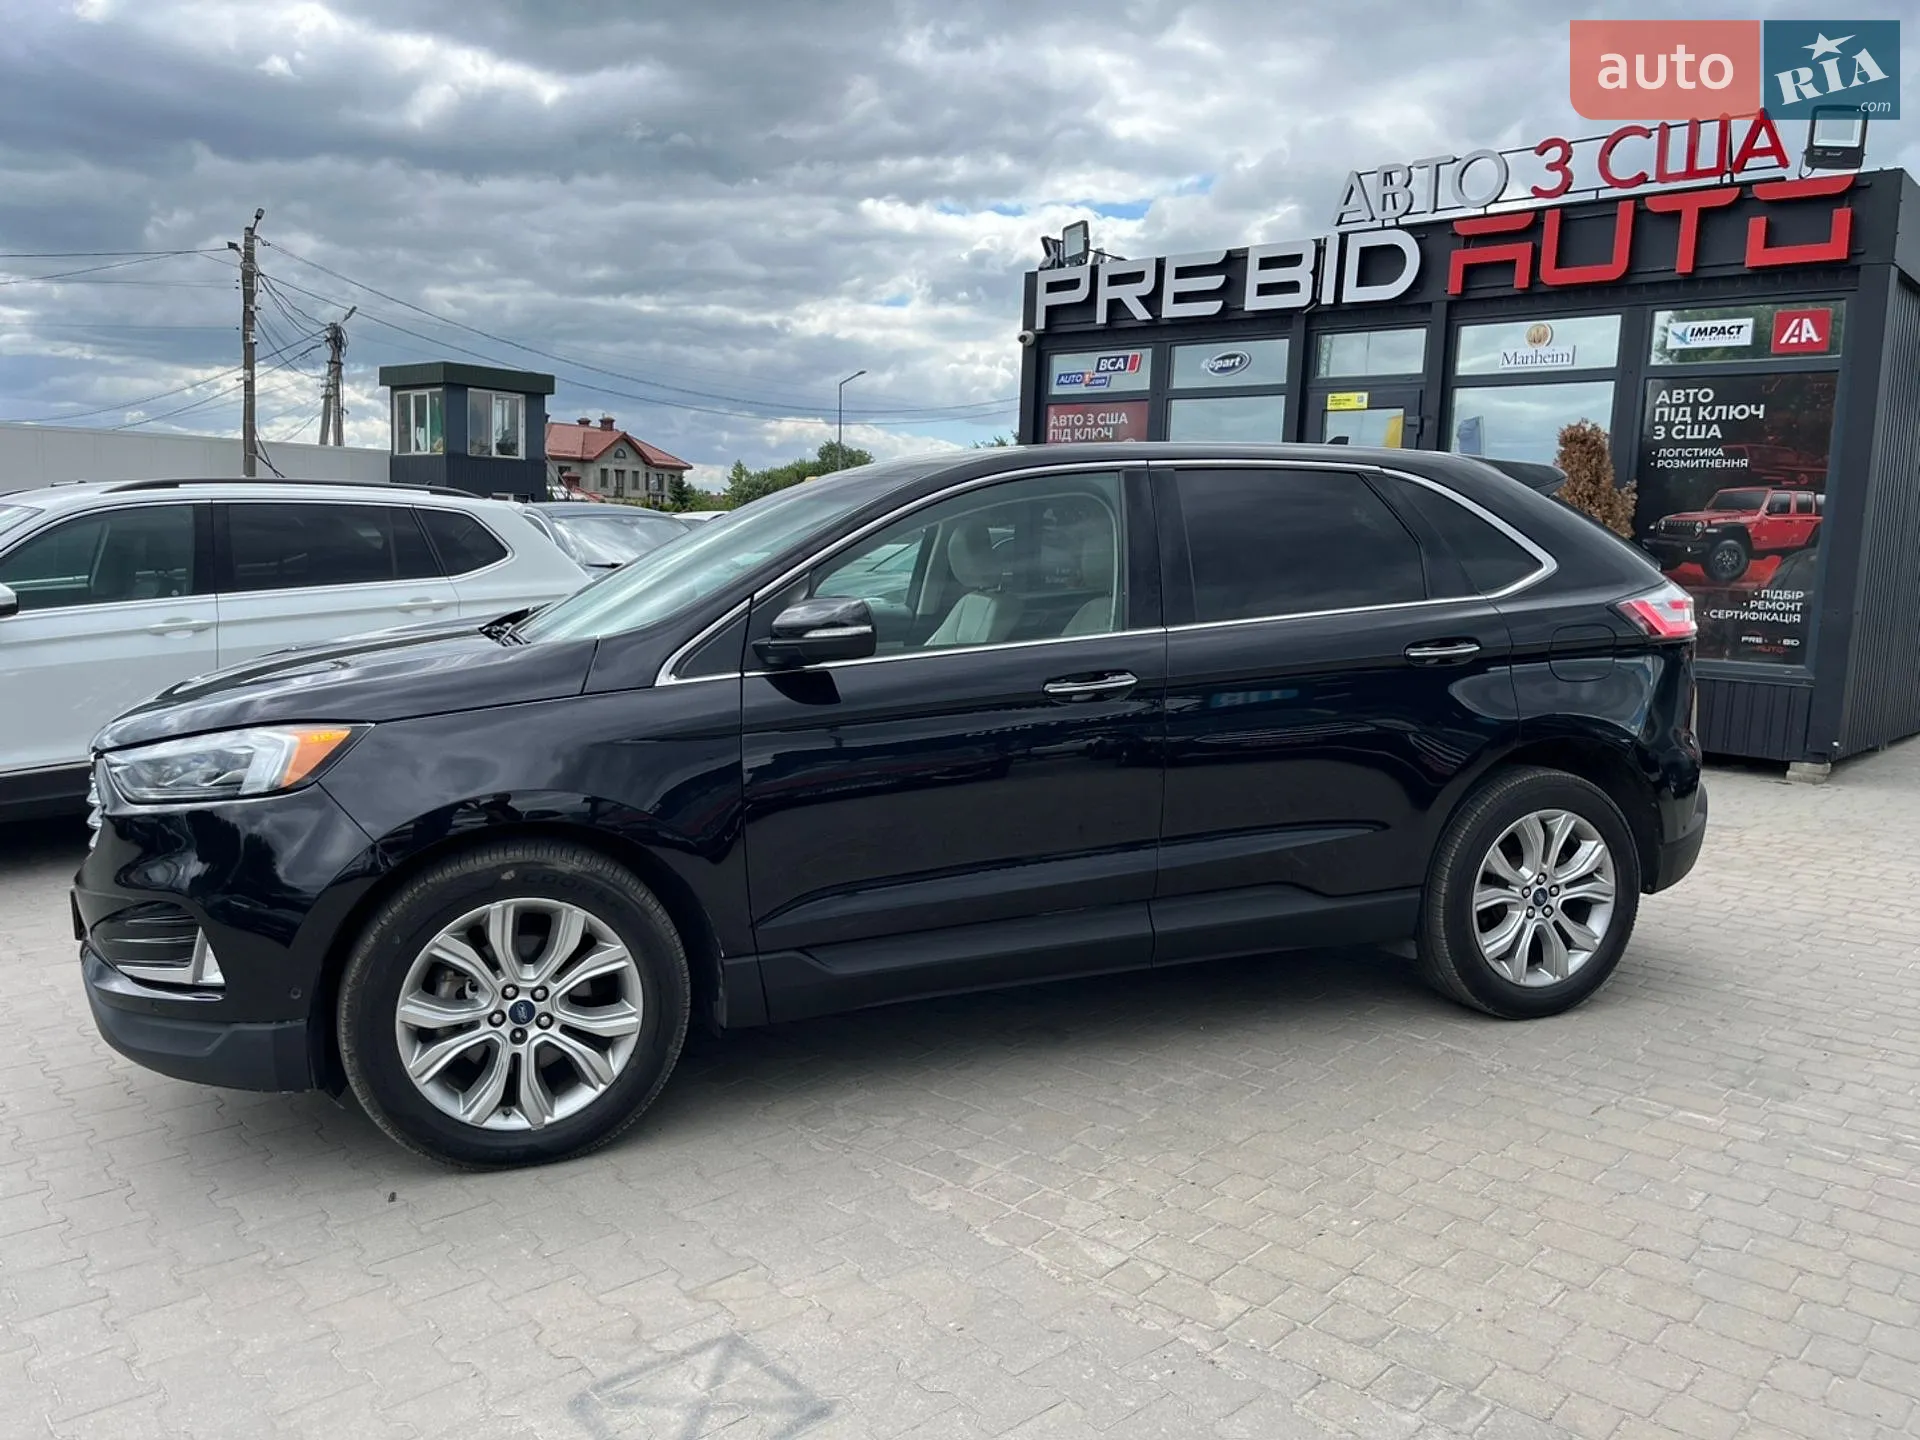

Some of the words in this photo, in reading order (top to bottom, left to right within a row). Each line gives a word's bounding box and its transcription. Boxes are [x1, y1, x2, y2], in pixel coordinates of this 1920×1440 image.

[1335, 148, 1508, 227] АВТО
[1531, 137, 1574, 199] З
[1597, 107, 1790, 188] США
[1036, 250, 1227, 330] PRE
[1244, 229, 1420, 312] BID
[1447, 175, 1854, 294] AUTO
[1690, 325, 1743, 337] IMPACT
[1098, 357, 1125, 371] BCA
[1501, 349, 1569, 366] Manheim
[1656, 388, 1714, 404] АВТО
[1050, 413, 1082, 427] АВТО
[1097, 411, 1129, 425] США
[1655, 407, 1691, 423] ПІД
[1698, 404, 1765, 420] КЛЮЧ
[1050, 428, 1071, 442] ПІД
[1074, 426, 1113, 440] КЛЮЧ
[1671, 424, 1722, 439] США
[1657, 448, 1724, 457] ЛОГІСТИКА
[1657, 458, 1748, 468] РОЗМИТНЕННЯ
[1761, 590, 1804, 600] ПІДБІР
[1749, 600, 1803, 611] РЕМОНТ
[1709, 609, 1801, 623] СЕРТИФІКАЦІЯ
